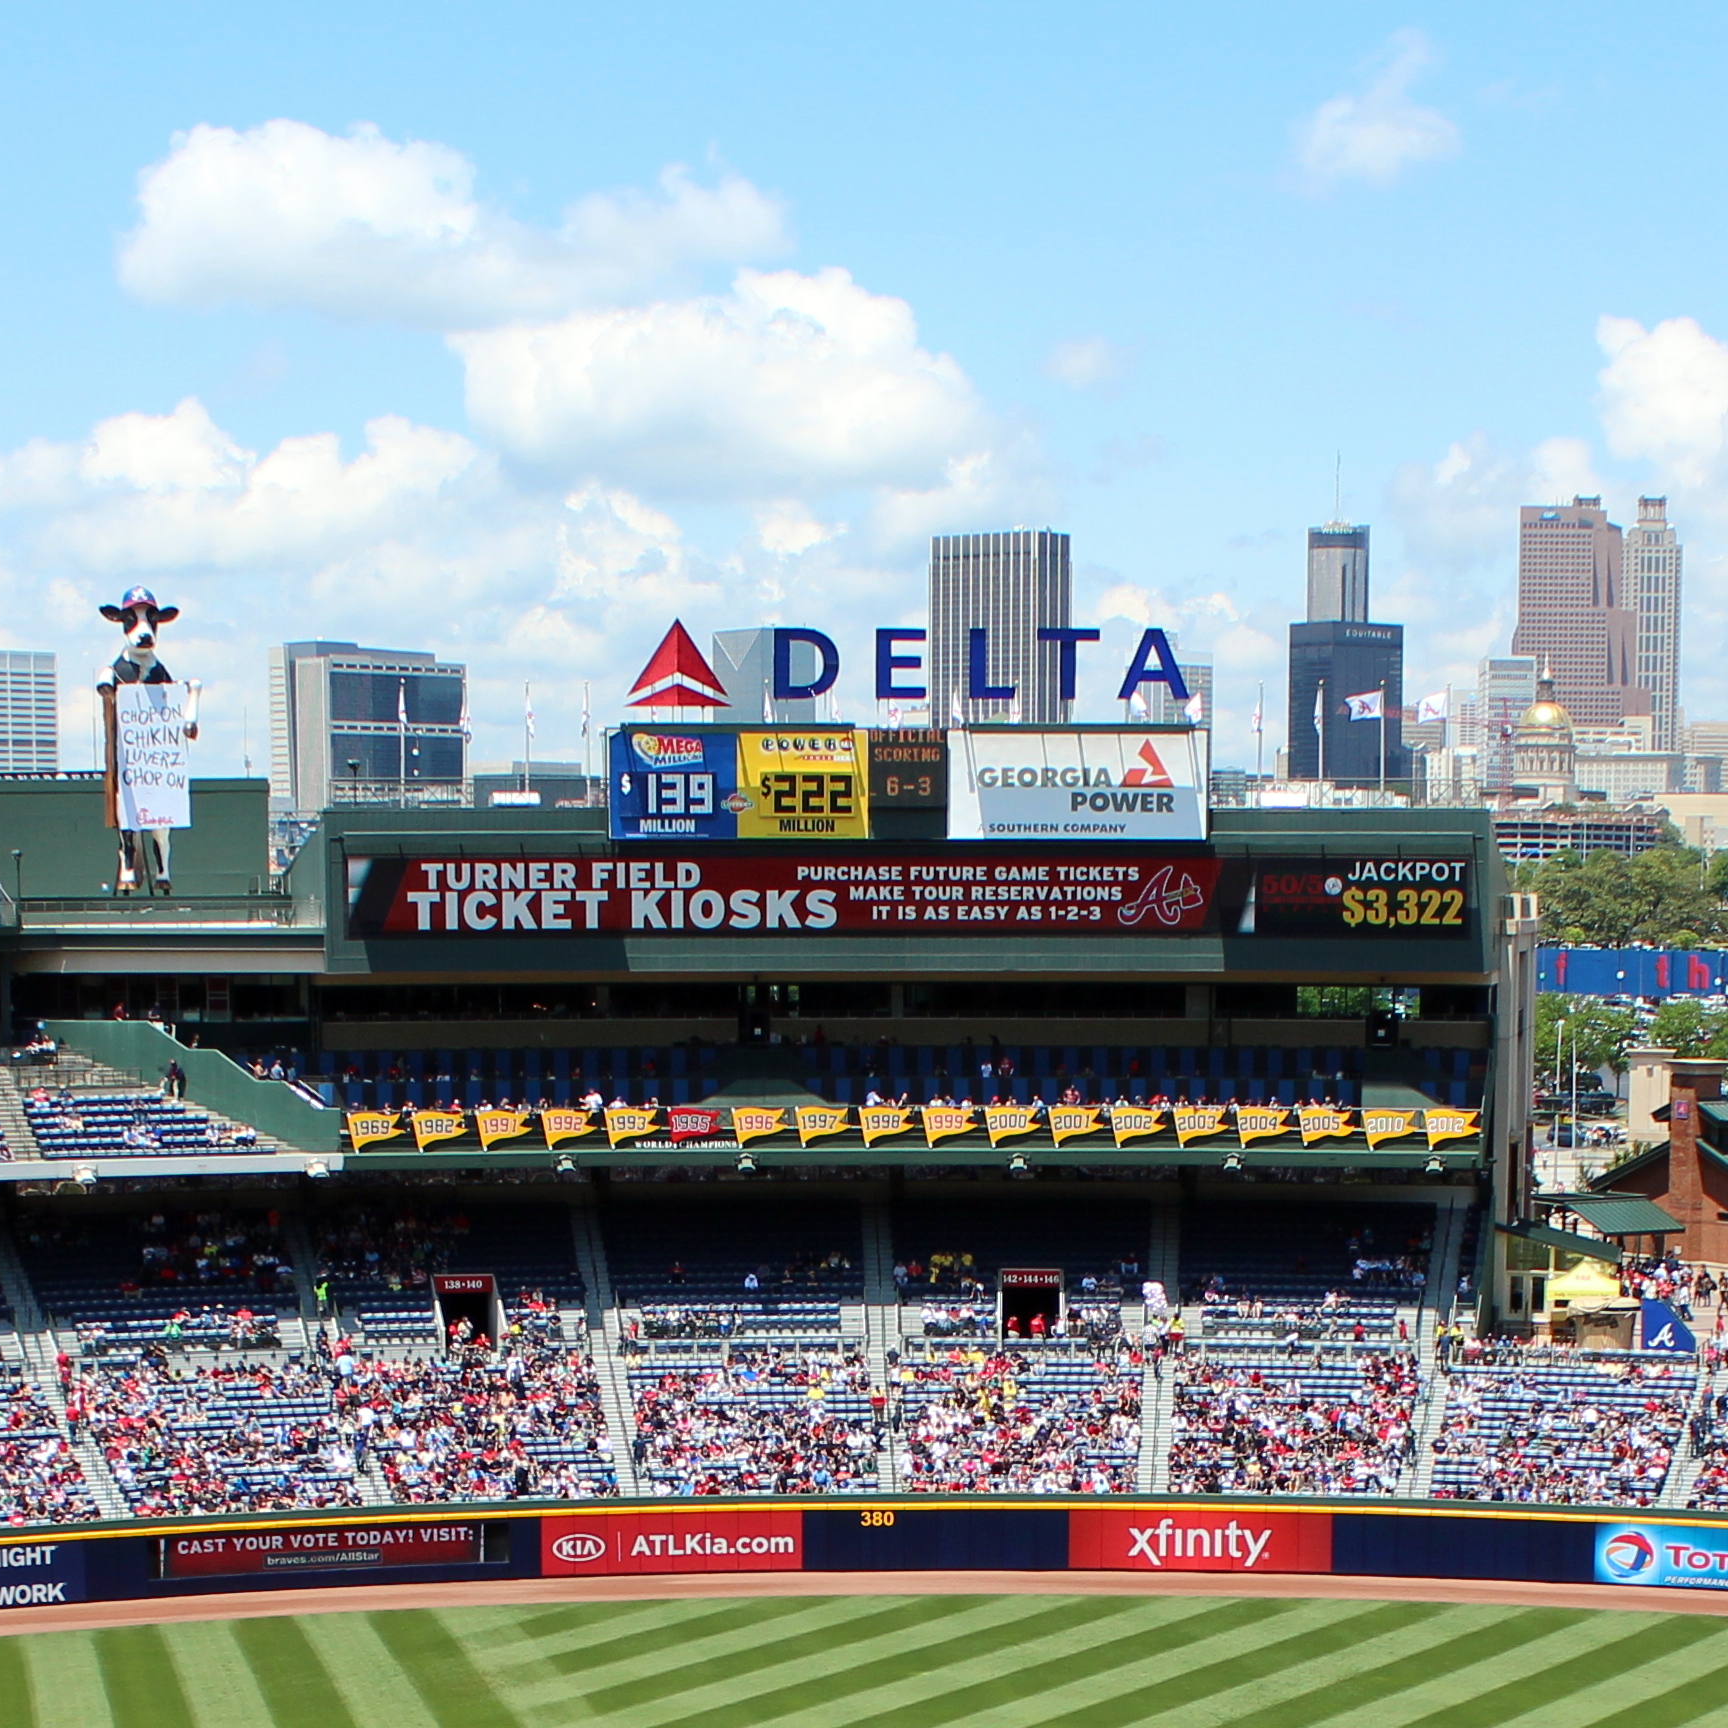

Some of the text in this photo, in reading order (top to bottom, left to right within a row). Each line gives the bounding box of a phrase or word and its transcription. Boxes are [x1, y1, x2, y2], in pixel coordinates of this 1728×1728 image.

[1345, 629, 1392, 640] EQUITABLE
[773, 628, 1189, 701] DELTA
[121, 705, 158, 726] CHOP
[124, 726, 181, 747] CHIKIN
[657, 735, 703, 753] MEGA
[869, 729, 946, 743] OFFICIAL
[874, 747, 940, 762] SCORING
[123, 768, 163, 787] CHOP
[166, 772, 186, 790] ON
[977, 766, 1113, 789] GEORGIA
[620, 773, 714, 814] $ 139
[761, 773, 853, 814] $ 222
[1071, 791, 1175, 814] POWER
[639, 818, 696, 834] MILLION
[779, 819, 835, 834] MILLION
[988, 822, 1060, 834] SOUTHERN
[1063, 823, 1127, 834] COMPANY
[421, 861, 701, 890] TURNER FIELD
[797, 866, 1140, 881] PURCHASE FUTURE GAME TICKETS
[1347, 861, 1466, 882] JACKPOT
[849, 885, 1123, 901] MAKE TOUR RESERVATIONS
[406, 889, 838, 931] TICKET KIOSKS
[872, 906, 1102, 922] IT IS AS EASY AS 1-2-3
[1342, 886, 1464, 928] $3,322
[354, 1119, 389, 1136] 1969
[417, 1118, 453, 1134] 1982
[482, 1117, 518, 1134] 1991
[546, 1116, 583, 1132] 1992
[610, 1116, 647, 1131] 1993
[671, 1116, 711, 1132] 1995
[737, 1116, 774, 1131] 1996
[801, 1115, 838, 1131] 1997
[864, 1115, 901, 1131] 1998
[927, 1116, 964, 1131] 1999
[988, 1115, 1027, 1130] 2000
[1053, 1115, 1091, 1130] 2001
[1114, 1116, 1153, 1131] 2002
[1177, 1116, 1216, 1131] 2003
[1238, 1116, 1278, 1132] 2004
[1301, 1116, 1340, 1132] 2005
[1367, 1117, 1405, 1134] 2010
[1427, 1116, 1465, 1134] 2012
[634, 1141, 737, 1149] WORLD CHAMPIONS
[860, 1511, 895, 1527] 380
[177, 1526, 474, 1555] CAST YOUR VOTE TODAY! VISIT:
[561, 1533, 794, 1557] KIA ATLKia.com
[1127, 1518, 1273, 1567] xfinity
[267, 1551, 380, 1567] braves.com/AllStar
